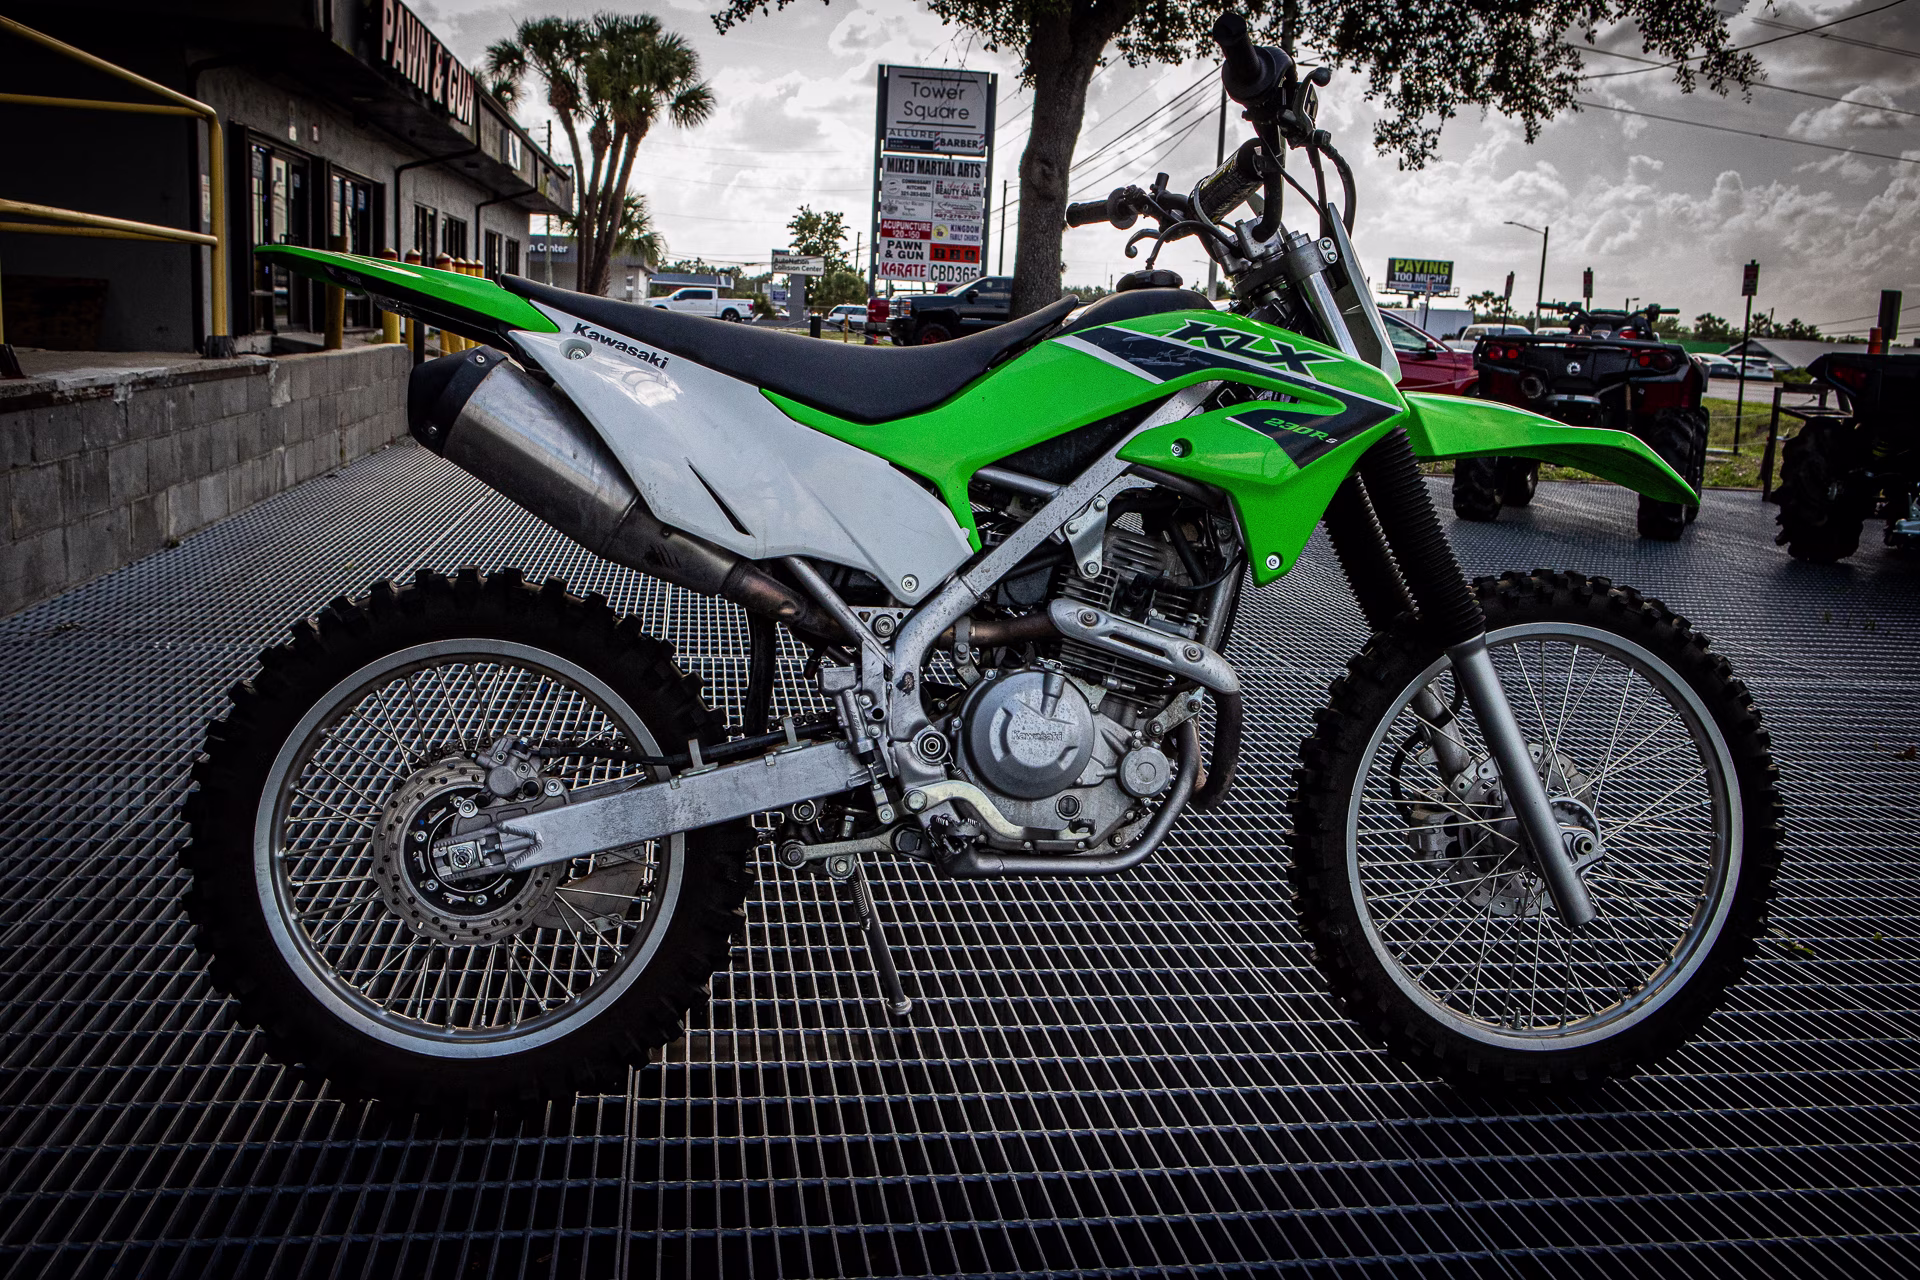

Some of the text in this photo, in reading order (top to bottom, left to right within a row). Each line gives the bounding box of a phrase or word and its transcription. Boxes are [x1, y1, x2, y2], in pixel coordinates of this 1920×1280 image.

[382, 0, 475, 126] PAWN & GUN
[911, 82, 965, 100] Tower
[904, 101, 970, 120] Square
[889, 128, 934, 139] ALLURE
[940, 138, 979, 149] BARBER
[886, 158, 981, 178] MIXED MARTIAL ARTS
[935, 187, 959, 196] BEAUTY
[960, 189, 981, 198] SALON
[882, 220, 931, 232] ACUPUNCTURE
[950, 224, 980, 234] KINGDOM
[892, 229, 921, 239] $20-$50
[887, 240, 922, 250] PAWN
[884, 249, 924, 260] & GUN
[881, 262, 927, 278] KARATE
[1395, 260, 1449, 274] PAYING
[930, 264, 977, 283] CBD365
[1394, 272, 1448, 283] TOO MUCH?
[572, 322, 669, 370] Kawasaki
[1162, 319, 1344, 381] KLX
[1011, 729, 1063, 741] Kawasaki
